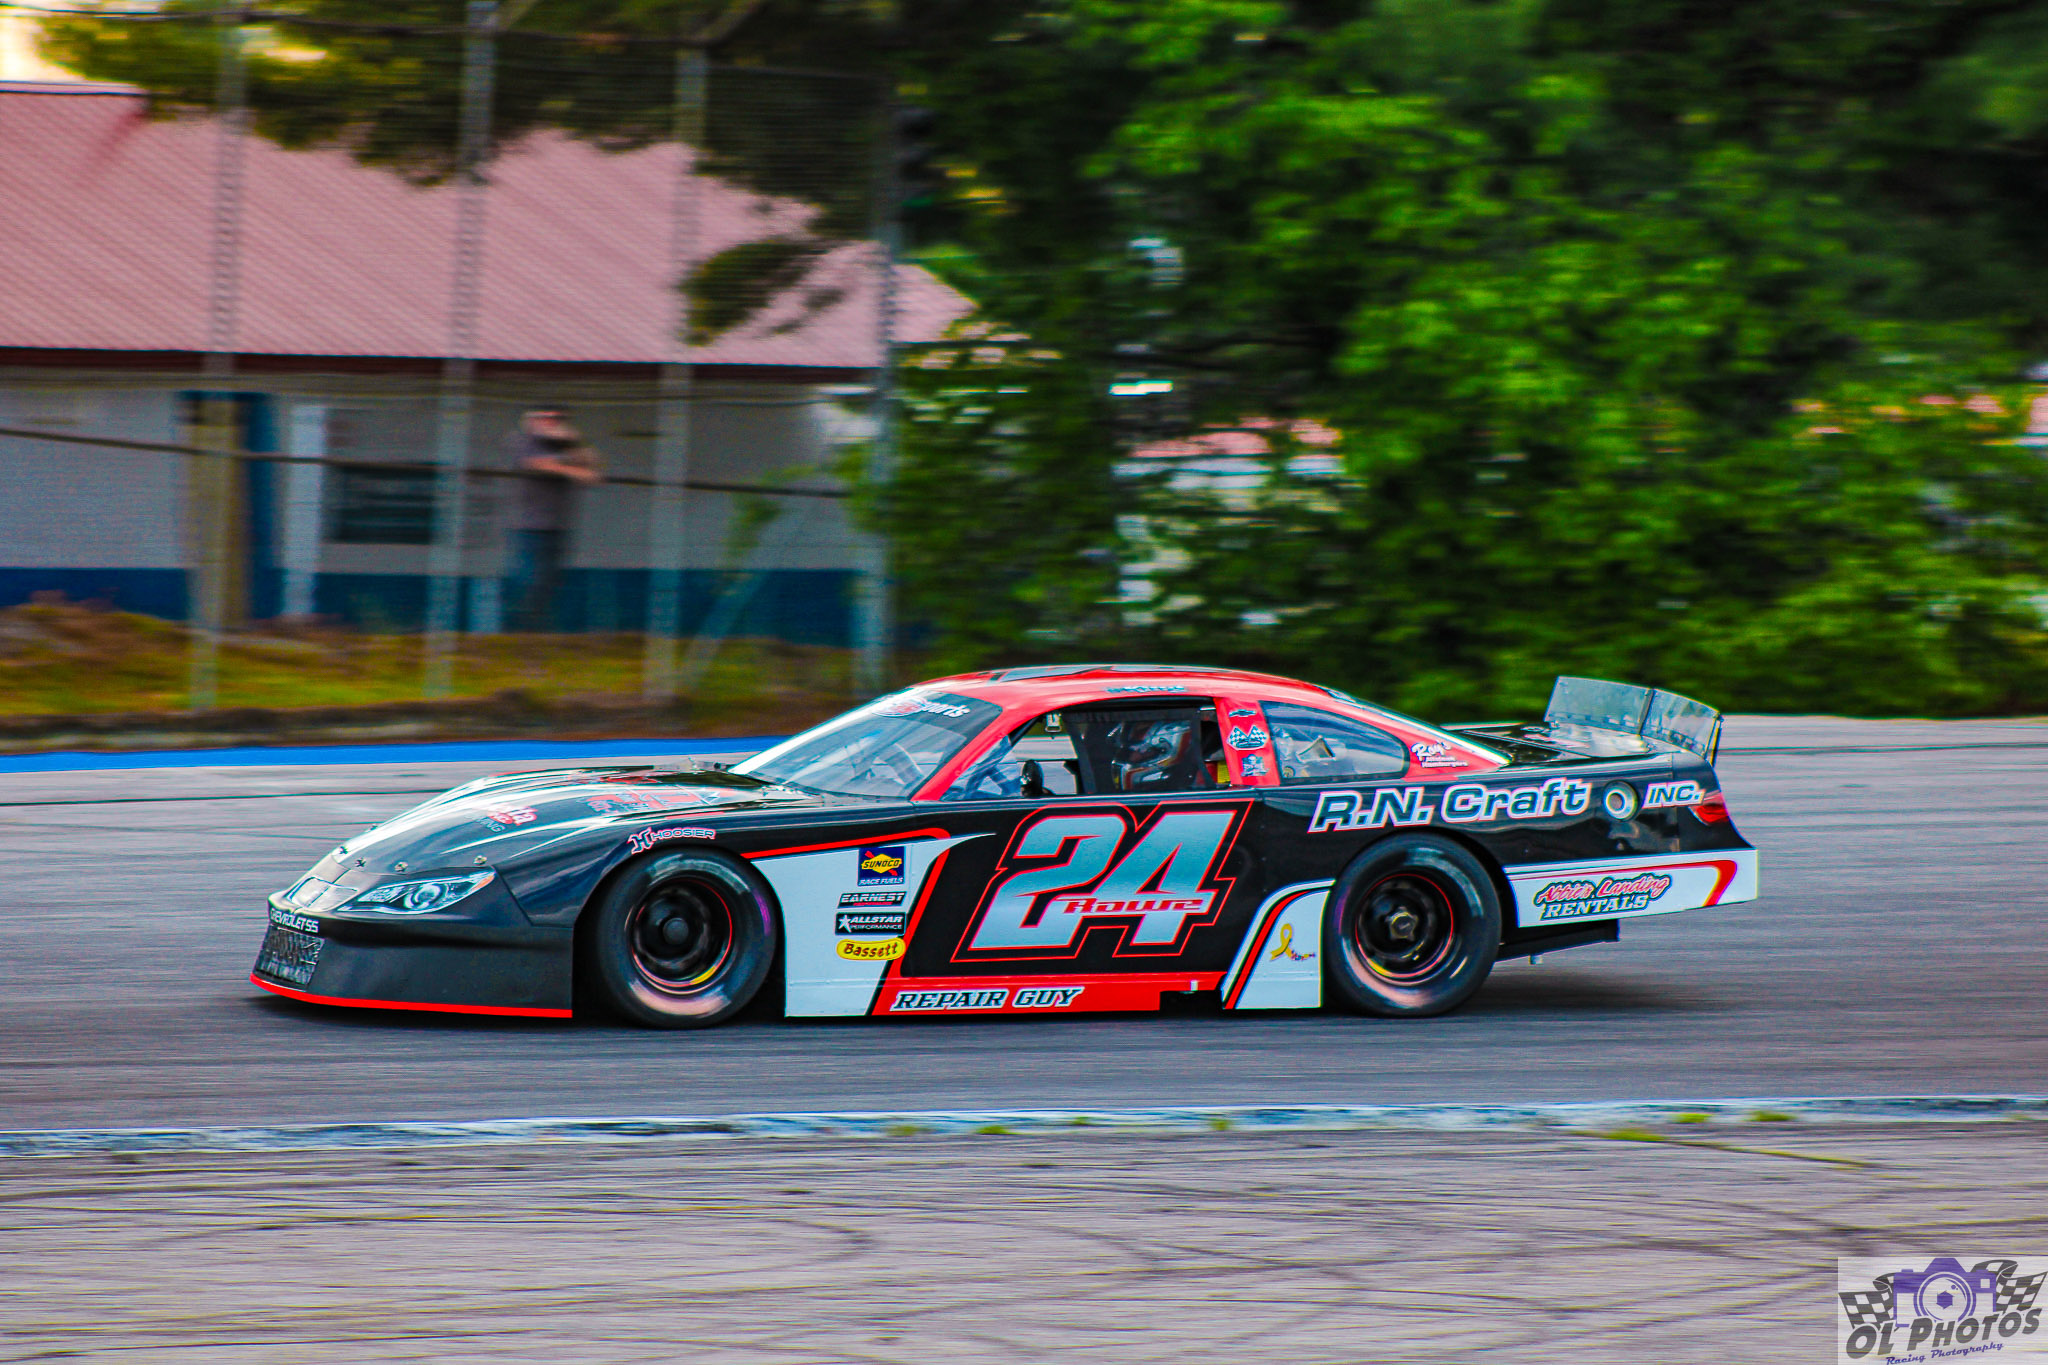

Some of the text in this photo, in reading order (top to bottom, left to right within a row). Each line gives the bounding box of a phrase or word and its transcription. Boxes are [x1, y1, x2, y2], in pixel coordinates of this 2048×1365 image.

[1308, 777, 1704, 833] R.N. Craft INC.
[650, 827, 717, 842] HOOSIER
[863, 859, 900, 869] SUNOCO
[968, 810, 1238, 951] 24
[1597, 875, 1671, 899] Landing
[841, 893, 905, 903] EARNEST
[843, 943, 898, 958] Bassett
[890, 986, 1085, 1011] REPAIR GUY
